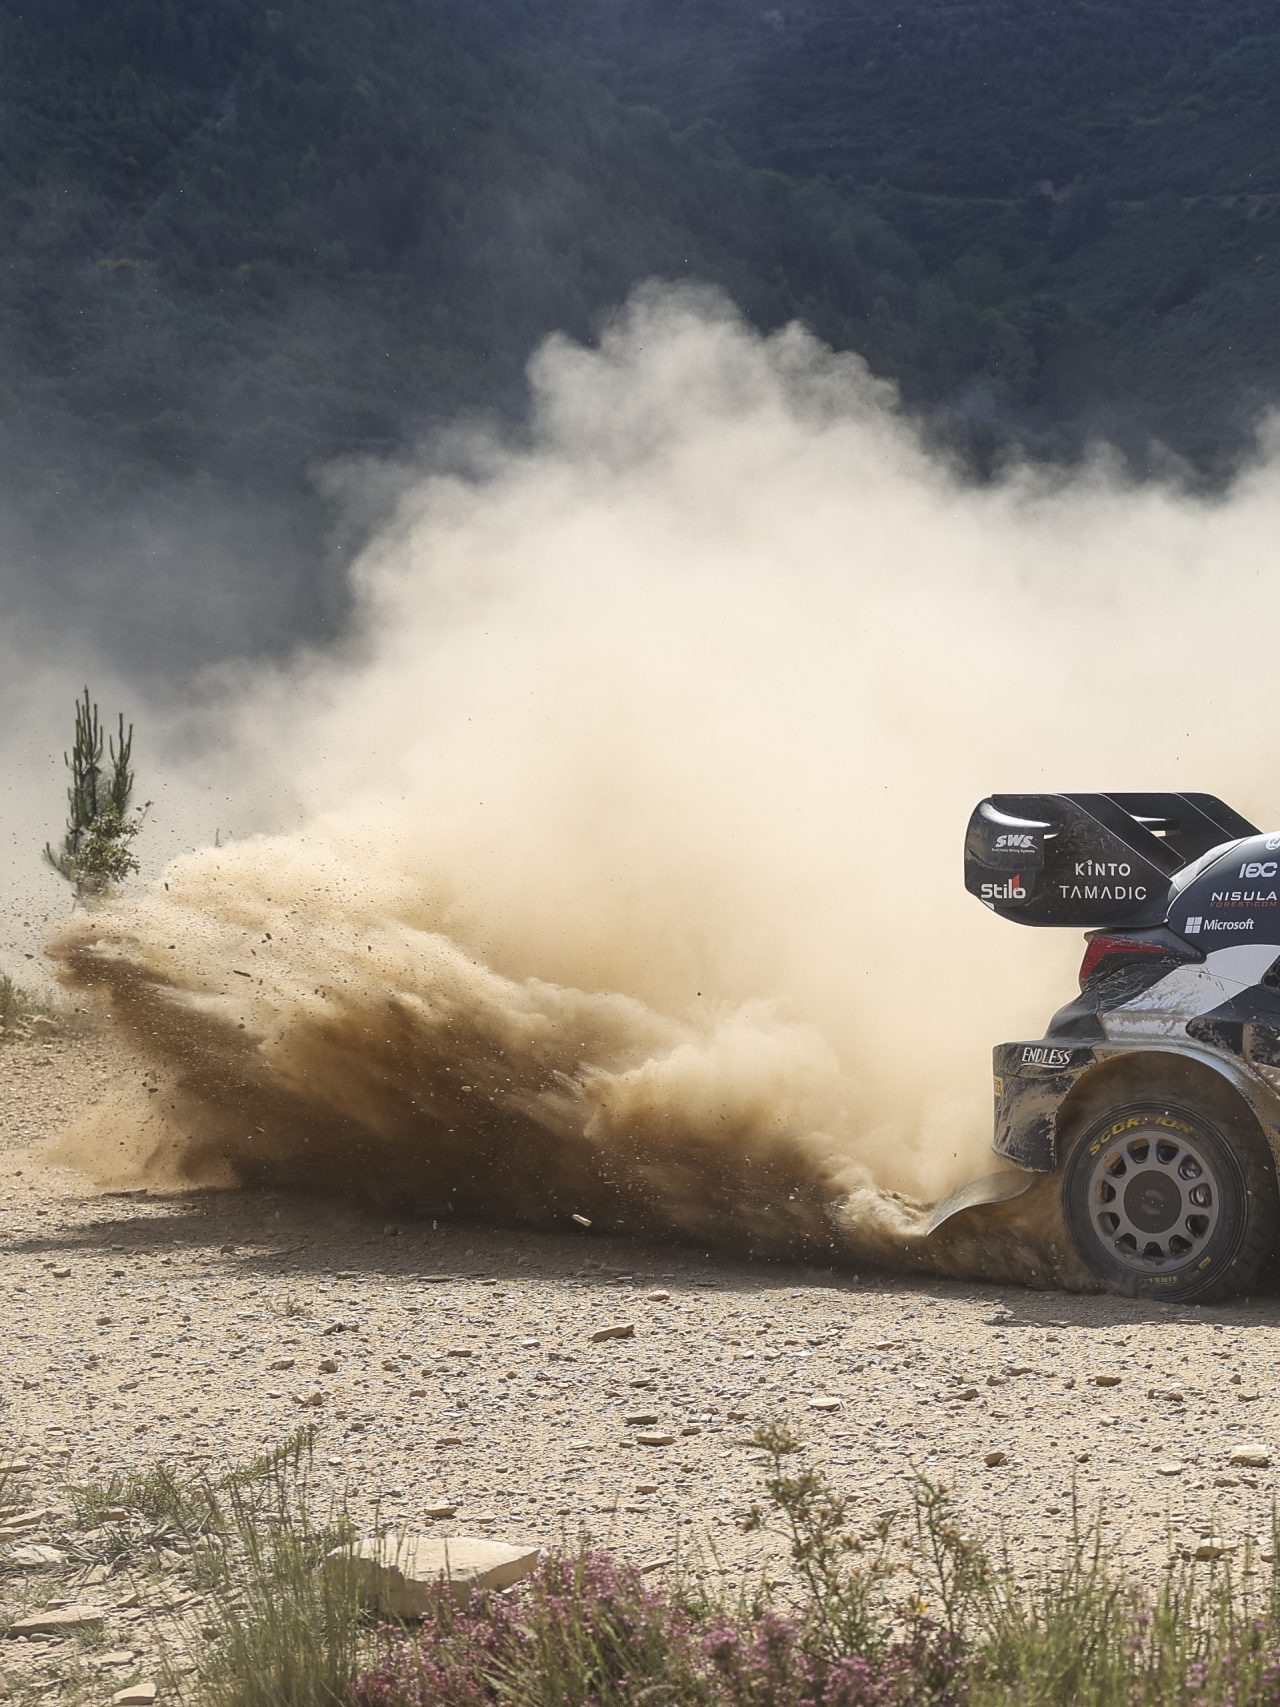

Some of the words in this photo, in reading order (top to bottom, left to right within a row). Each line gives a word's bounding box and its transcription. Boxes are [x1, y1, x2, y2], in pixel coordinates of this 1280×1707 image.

[995, 834, 1038, 849] SWS
[981, 879, 1026, 899] Stilo
[1059, 885, 1147, 901] TAMADIC
[1211, 891, 1278, 901] NISULA
[1203, 918, 1255, 930] Microsoft
[1022, 1047, 1072, 1065] ENDLESS
